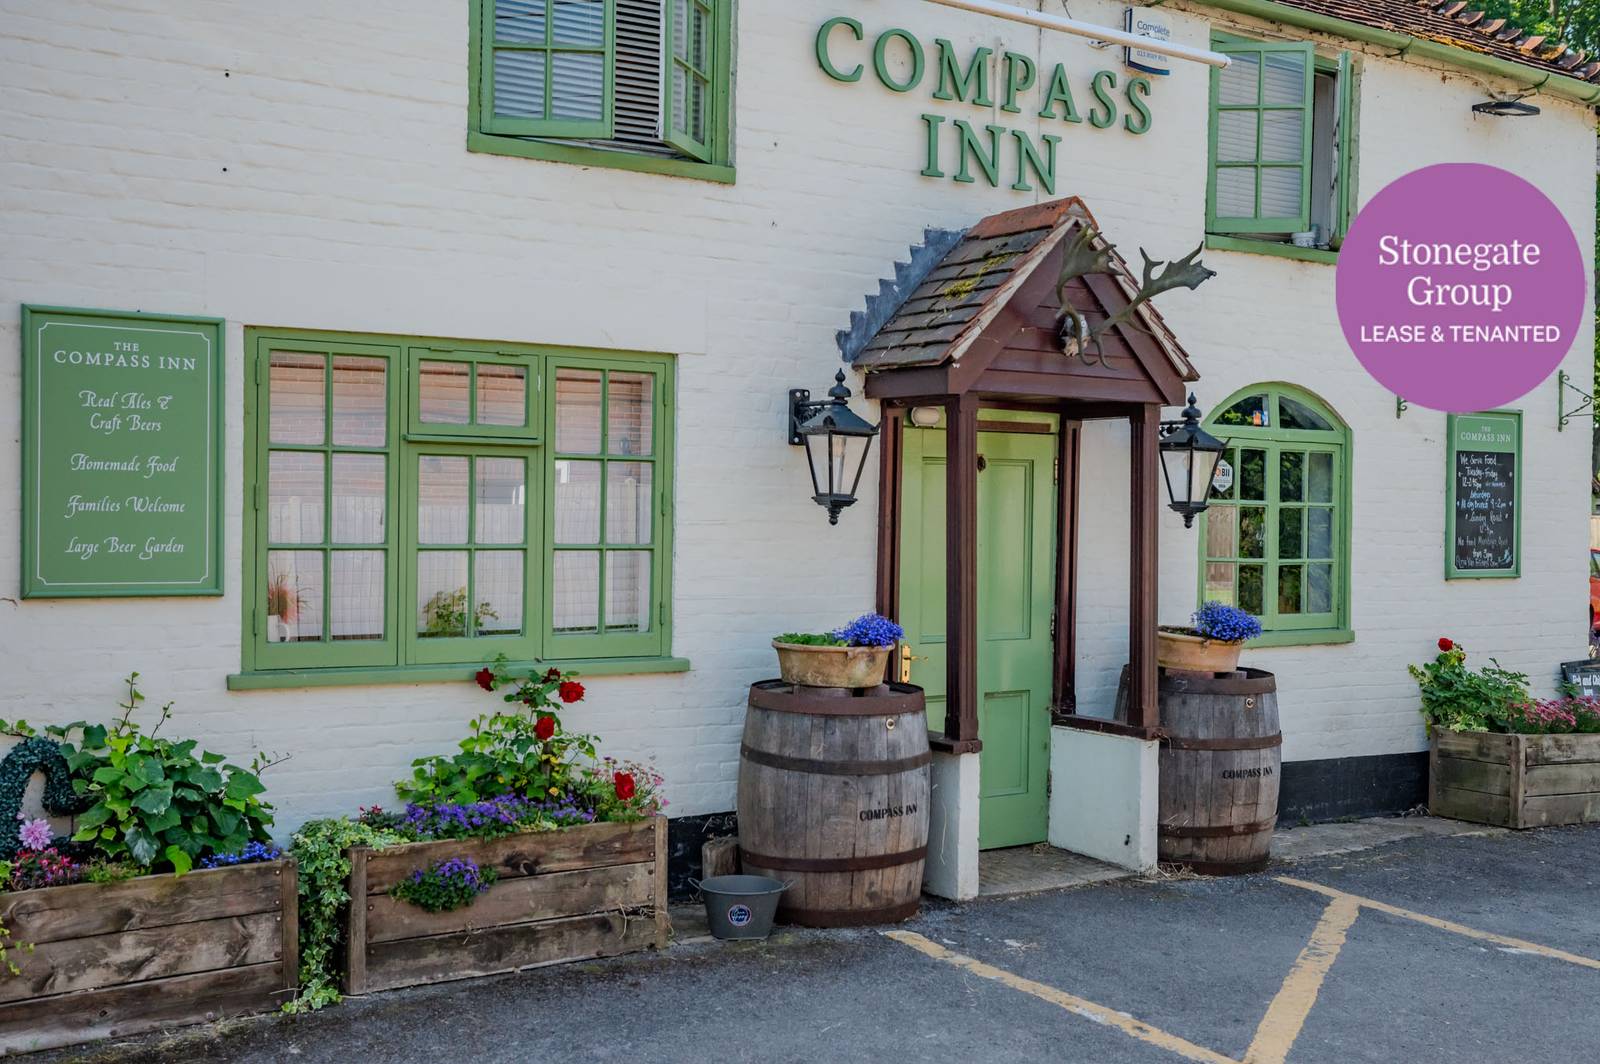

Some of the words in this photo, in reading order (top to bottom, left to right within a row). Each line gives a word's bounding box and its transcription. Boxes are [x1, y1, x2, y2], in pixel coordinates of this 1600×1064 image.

[815, 16, 1152, 135] COMPASS
[920, 113, 1063, 195] INN
[114, 341, 139, 352] THE
[54, 350, 150, 368] COMPASS
[160, 356, 196, 370] INN
[79, 390, 118, 408] Real
[121, 391, 151, 409] Ales
[157, 395, 173, 410] &
[90, 412, 122, 435] Craft
[127, 414, 161, 432] Beers
[1460, 431, 1495, 442] COMPASS
[70, 453, 140, 471] Homemade
[144, 455, 180, 479] Food
[64, 495, 120, 518] Families
[125, 496, 185, 512] Welcome
[65, 536, 99, 560] Large
[104, 536, 136, 552] Beer
[139, 536, 184, 560] Garden
[1223, 767, 1261, 779] COMPASS
[860, 806, 903, 822] COMPASS
[906, 803, 917, 815] INN
